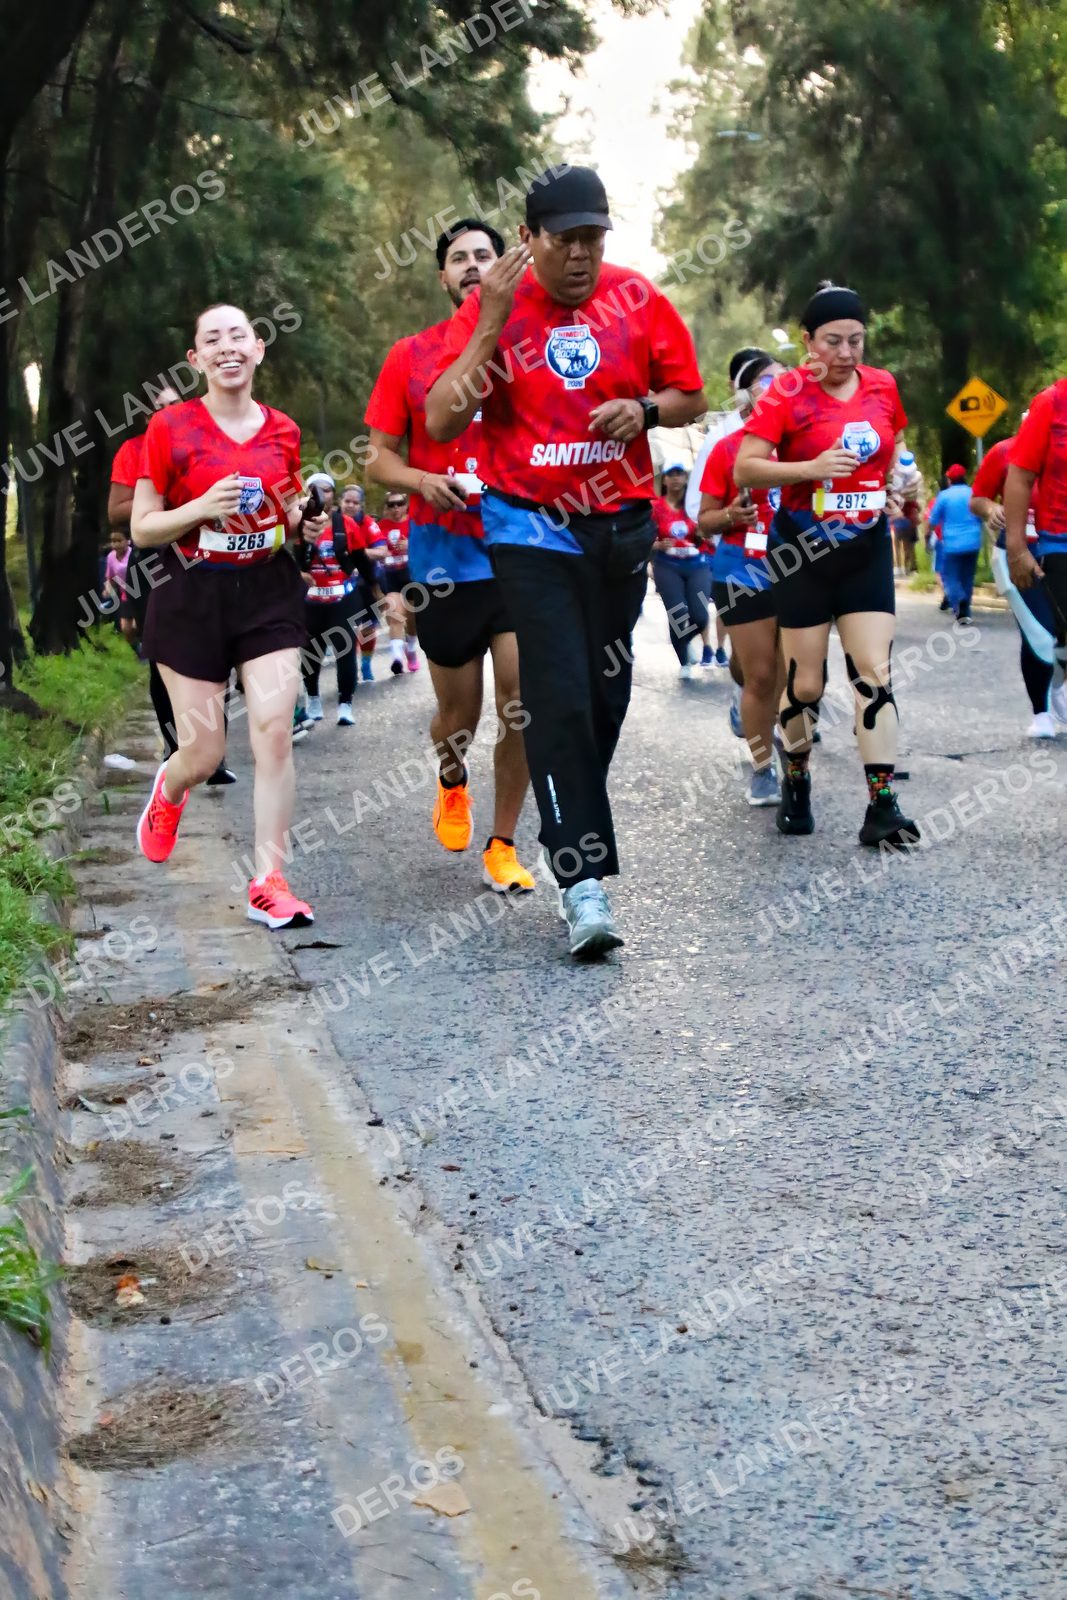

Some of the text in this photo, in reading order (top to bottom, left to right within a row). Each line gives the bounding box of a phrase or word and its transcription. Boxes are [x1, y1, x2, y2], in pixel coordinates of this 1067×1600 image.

[559, 340, 586, 350] Global
[554, 349, 576, 359] Race
[836, 493, 867, 509] 2972
[226, 533, 266, 551] 3263
